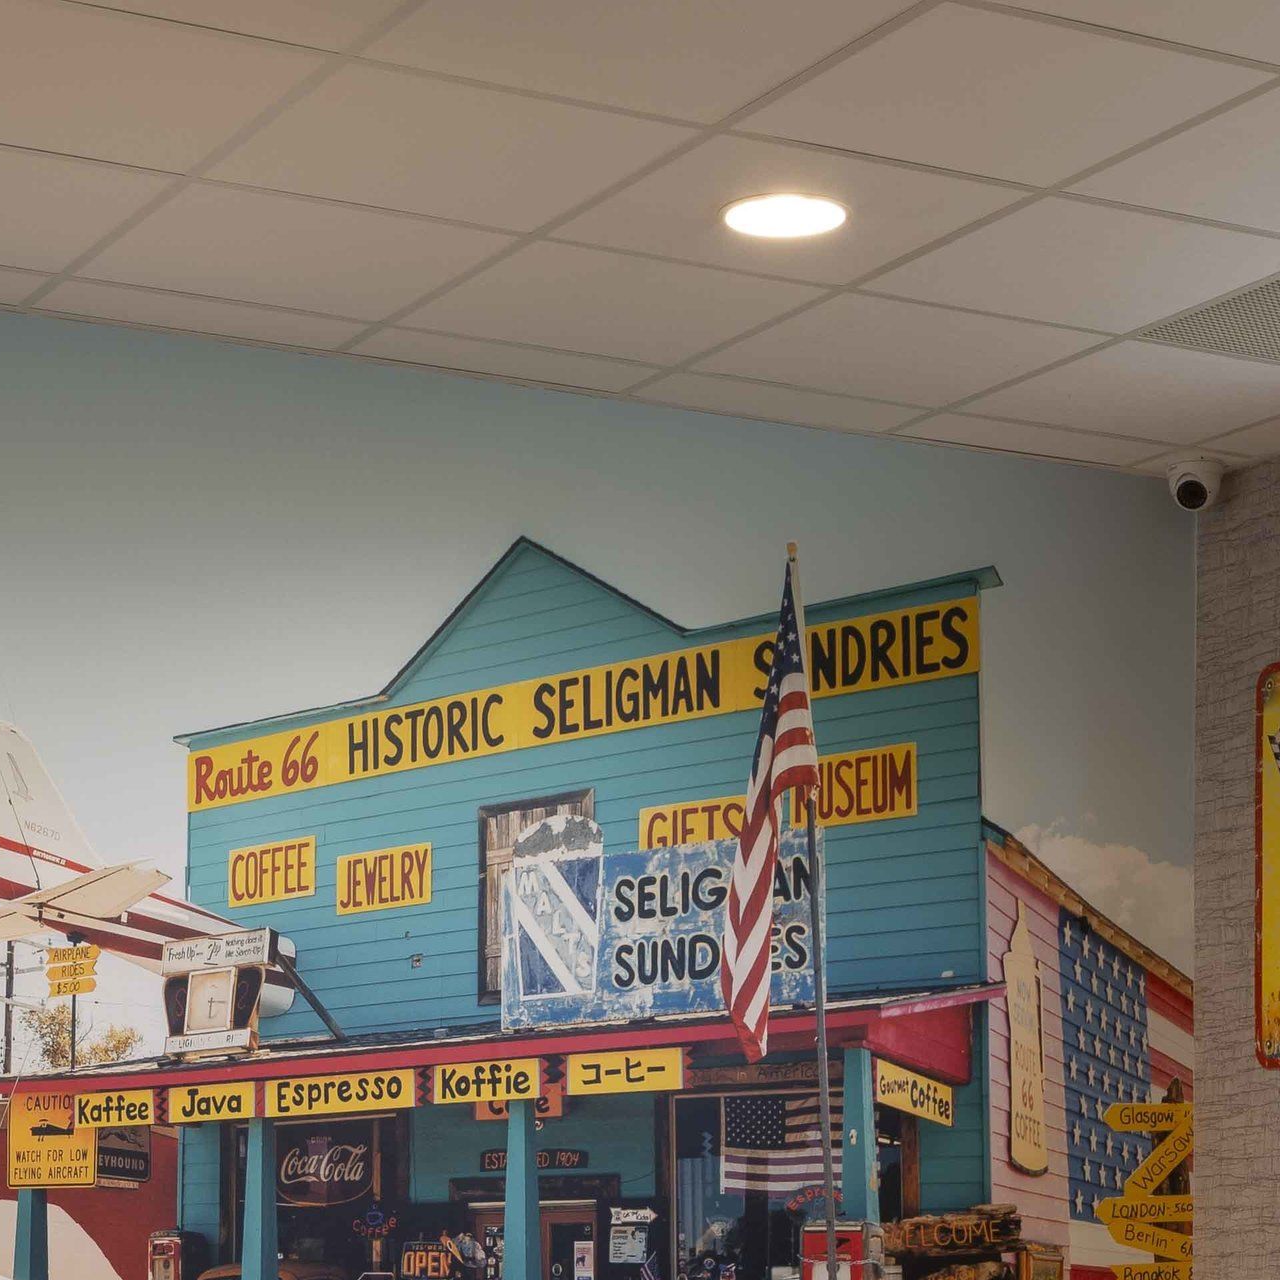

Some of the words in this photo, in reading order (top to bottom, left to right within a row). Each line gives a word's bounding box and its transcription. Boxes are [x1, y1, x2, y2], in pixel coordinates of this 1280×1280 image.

[194, 749, 273, 804] Route
[281, 730, 320, 787] 66
[347, 692, 505, 775] HISTORIC
[532, 649, 720, 738] SELIGMAN
[753, 605, 969, 700] SNDRIES
[231, 841, 310, 901] COFFEE
[339, 848, 428, 909] JEWELRY
[614, 857, 814, 922] SELIGAN
[52, 946, 91, 961] AIRPLANE
[614, 924, 808, 988] SUNDES
[61, 963, 85, 977] RIDES
[441, 1064, 532, 1099] Koffie
[581, 1056, 666, 1085] コーヒー
[26, 1094, 74, 1111] CAUTIO
[181, 1088, 242, 1117] Java
[276, 1075, 403, 1113] Espresso
[910, 1079, 950, 1120] Coffee
[1020, 1079, 1035, 1112] 66
[78, 1095, 149, 1125] Kaffee
[1014, 1113, 1042, 1149] COFFEE
[15, 1150, 41, 1163] WATCH
[47, 1149, 64, 1162] FOR
[70, 1148, 88, 1162] LOW
[98, 1155, 145, 1171] EYHOUND
[281, 1144, 368, 1184] Coca-Cola
[555, 1152, 580, 1167] 1904
[1132, 1126, 1193, 1190] Warsaw
[14, 1167, 42, 1180] FLYING
[48, 1166, 89, 1179] AIRCRAFT
[882, 1219, 1003, 1249] WELCOME
[403, 1251, 452, 1278] OPEN
